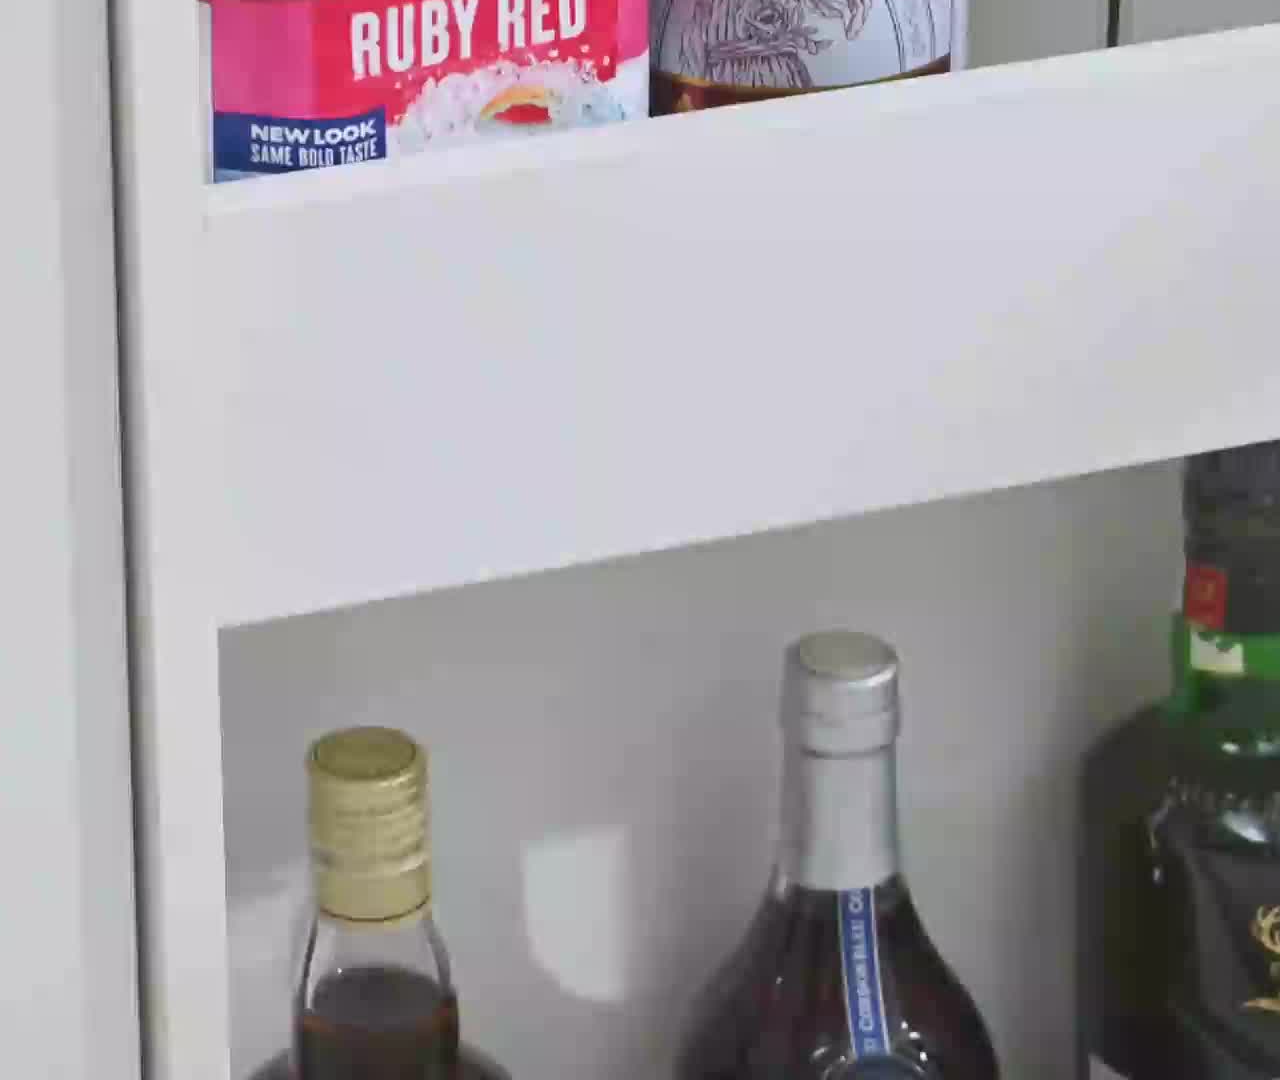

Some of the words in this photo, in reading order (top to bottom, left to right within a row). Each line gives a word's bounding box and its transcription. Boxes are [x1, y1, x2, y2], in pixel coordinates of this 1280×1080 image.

[250, 123, 310, 145] NEW
[314, 118, 377, 145] LOOK
[250, 143, 293, 167] SAME
[298, 147, 334, 168] BOLD
[340, 137, 378, 165] TASTE
